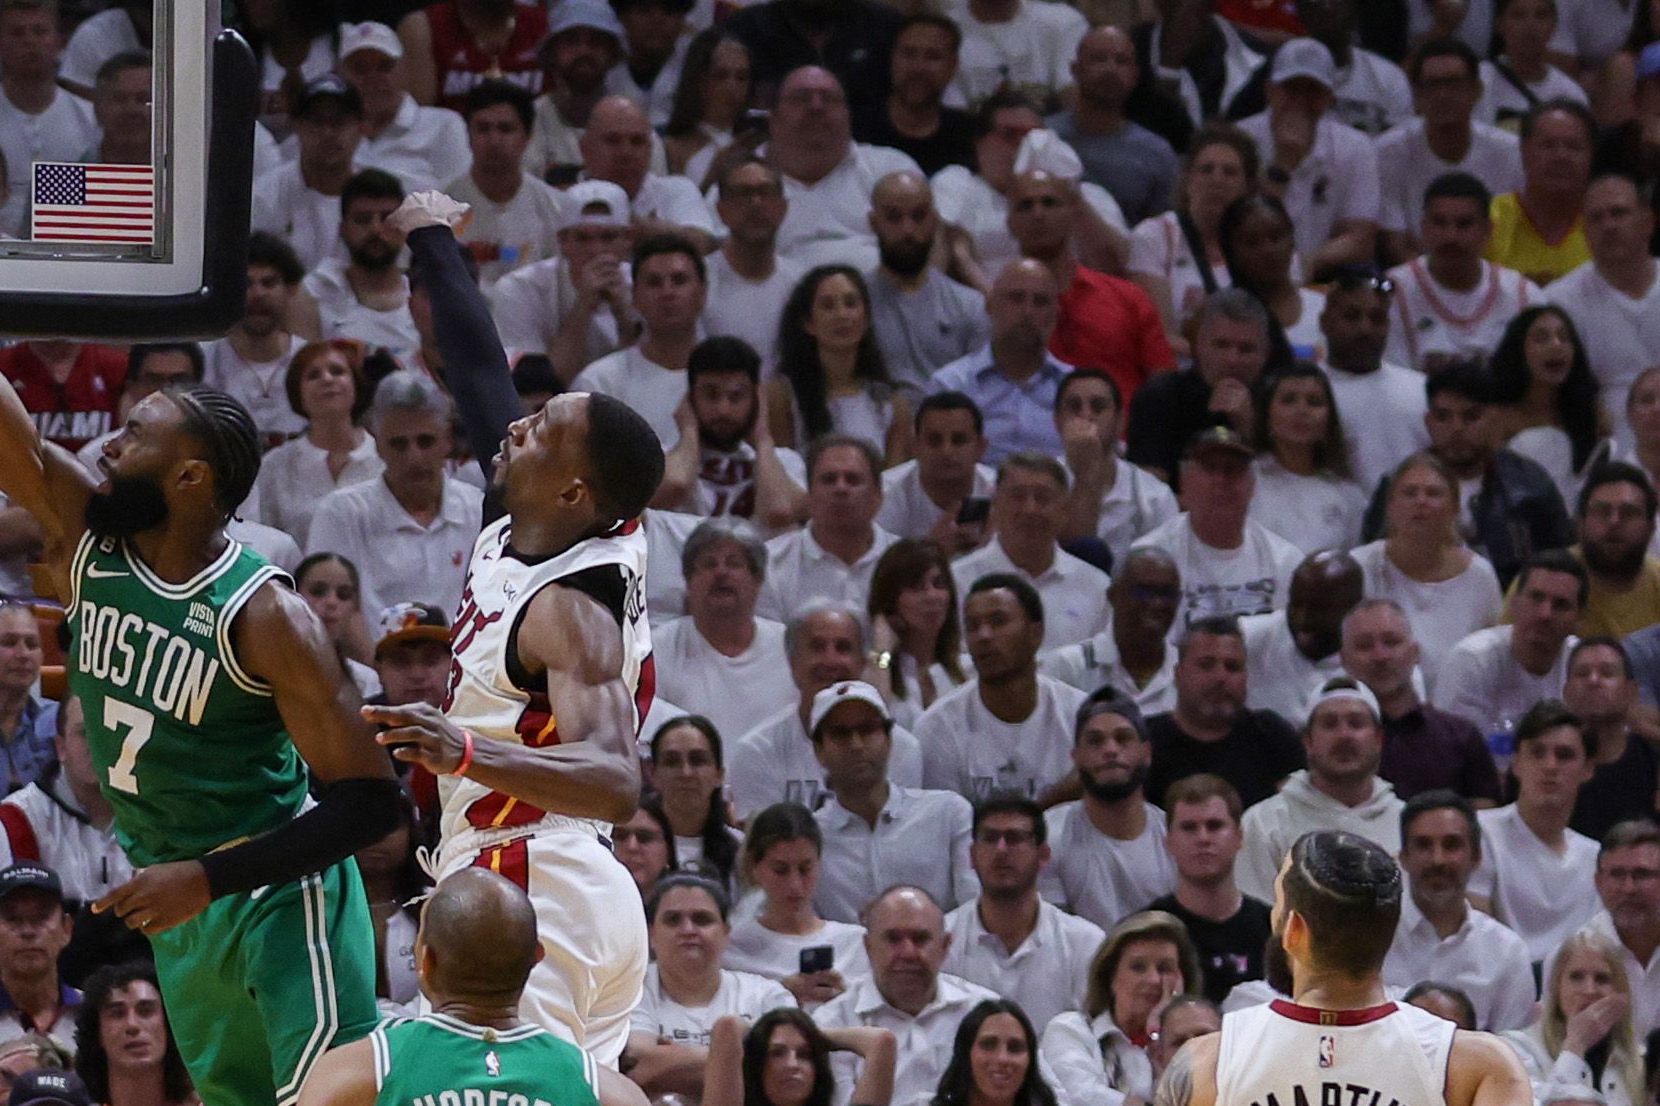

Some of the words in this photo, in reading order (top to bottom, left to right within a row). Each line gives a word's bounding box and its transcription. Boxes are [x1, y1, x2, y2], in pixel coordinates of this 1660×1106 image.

[34, 411, 92, 437] IAMI
[189, 601, 215, 627] VISTA
[182, 616, 214, 639] PRINT
[78, 599, 220, 727] BOSTON
[103, 695, 156, 795] 7
[37, 1076, 68, 1088] WADE
